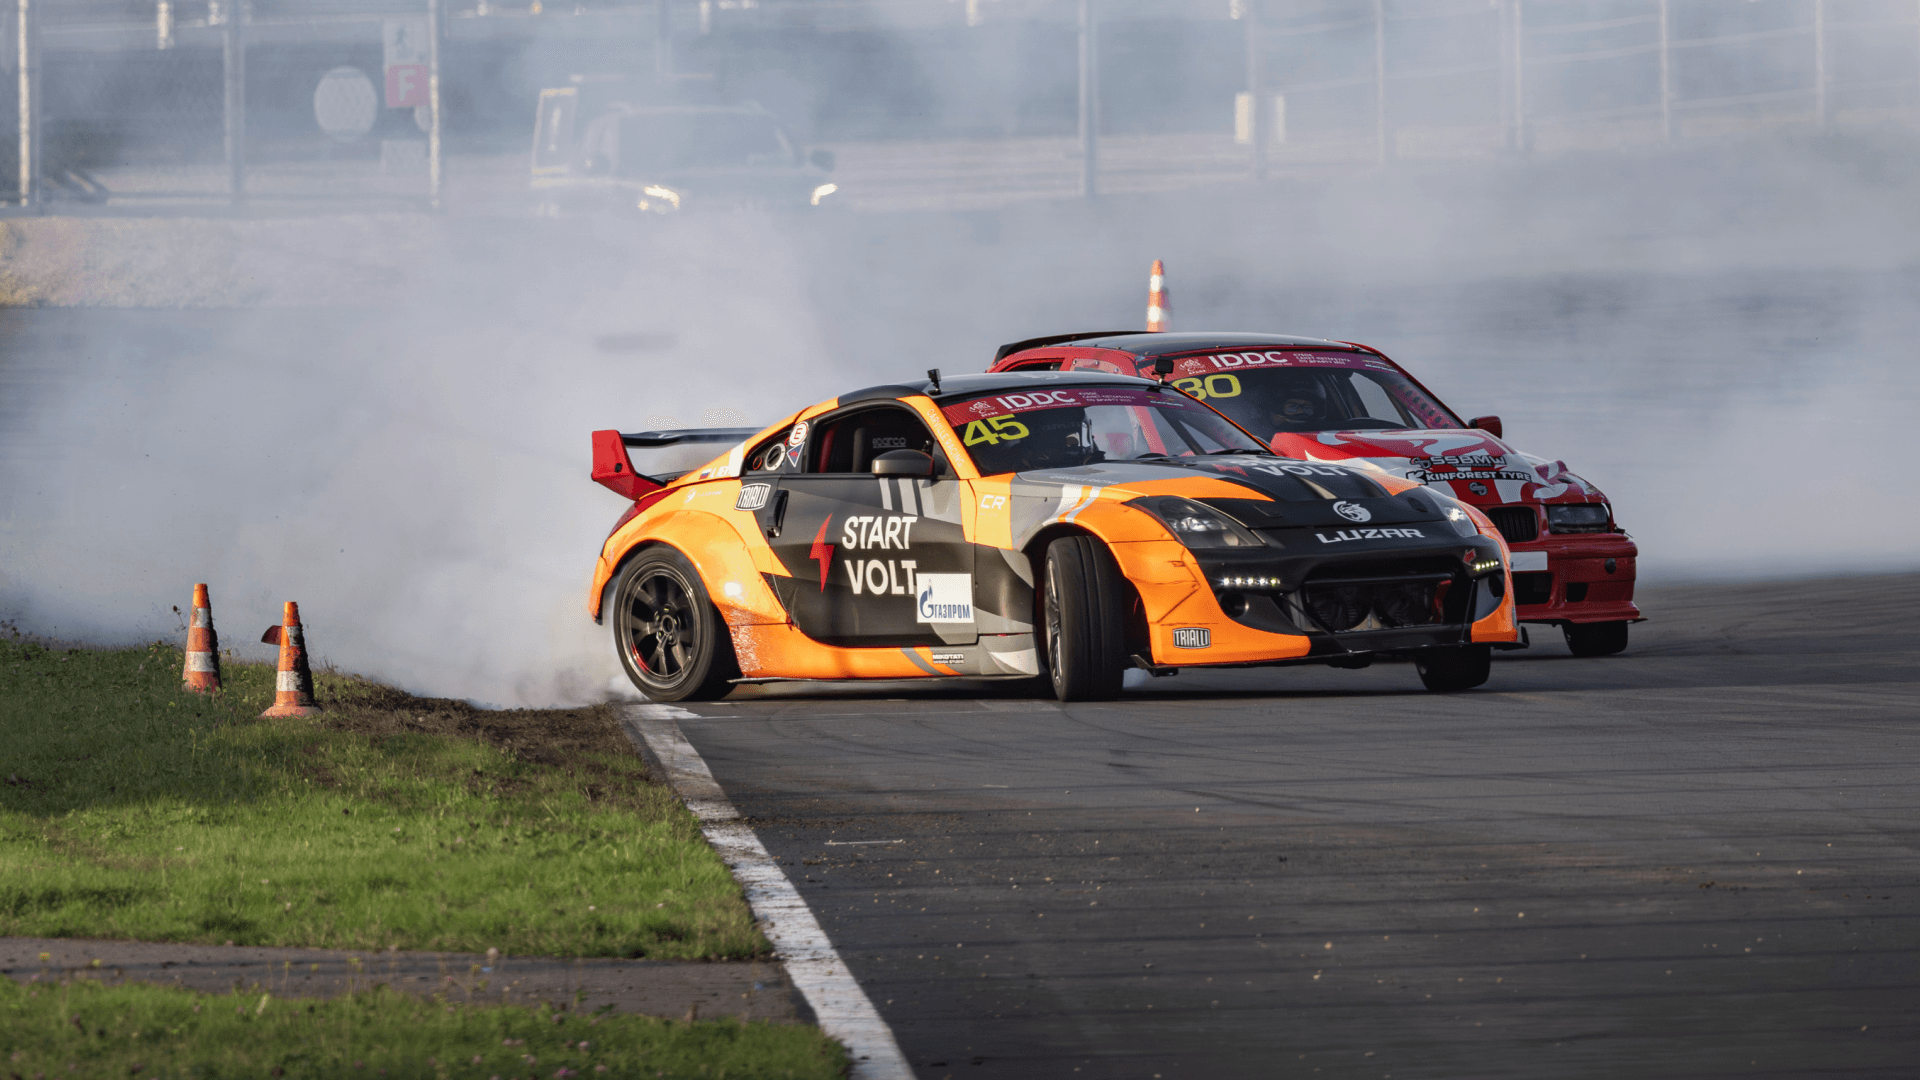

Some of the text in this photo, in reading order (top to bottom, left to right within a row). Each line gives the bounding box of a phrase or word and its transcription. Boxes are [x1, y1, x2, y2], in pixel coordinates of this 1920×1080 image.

[1207, 350, 1289, 368] IDDC
[1171, 373, 1242, 401] 30
[995, 390, 1077, 410] IDDC
[962, 413, 1030, 447] 45
[1429, 454, 1508, 465] SSBMW
[1252, 465, 1349, 476] VOLT
[1426, 471, 1497, 481] KINFOREST
[1500, 471, 1532, 481] TYRE
[736, 485, 769, 508] TRIALLI
[980, 494, 1006, 510] CR
[841, 516, 918, 550] START
[1315, 528, 1426, 544] LUZAR
[844, 559, 918, 595] VOLT
[933, 604, 971, 619] ГАЗПРОМ
[1174, 629, 1209, 647] TRIALLI
